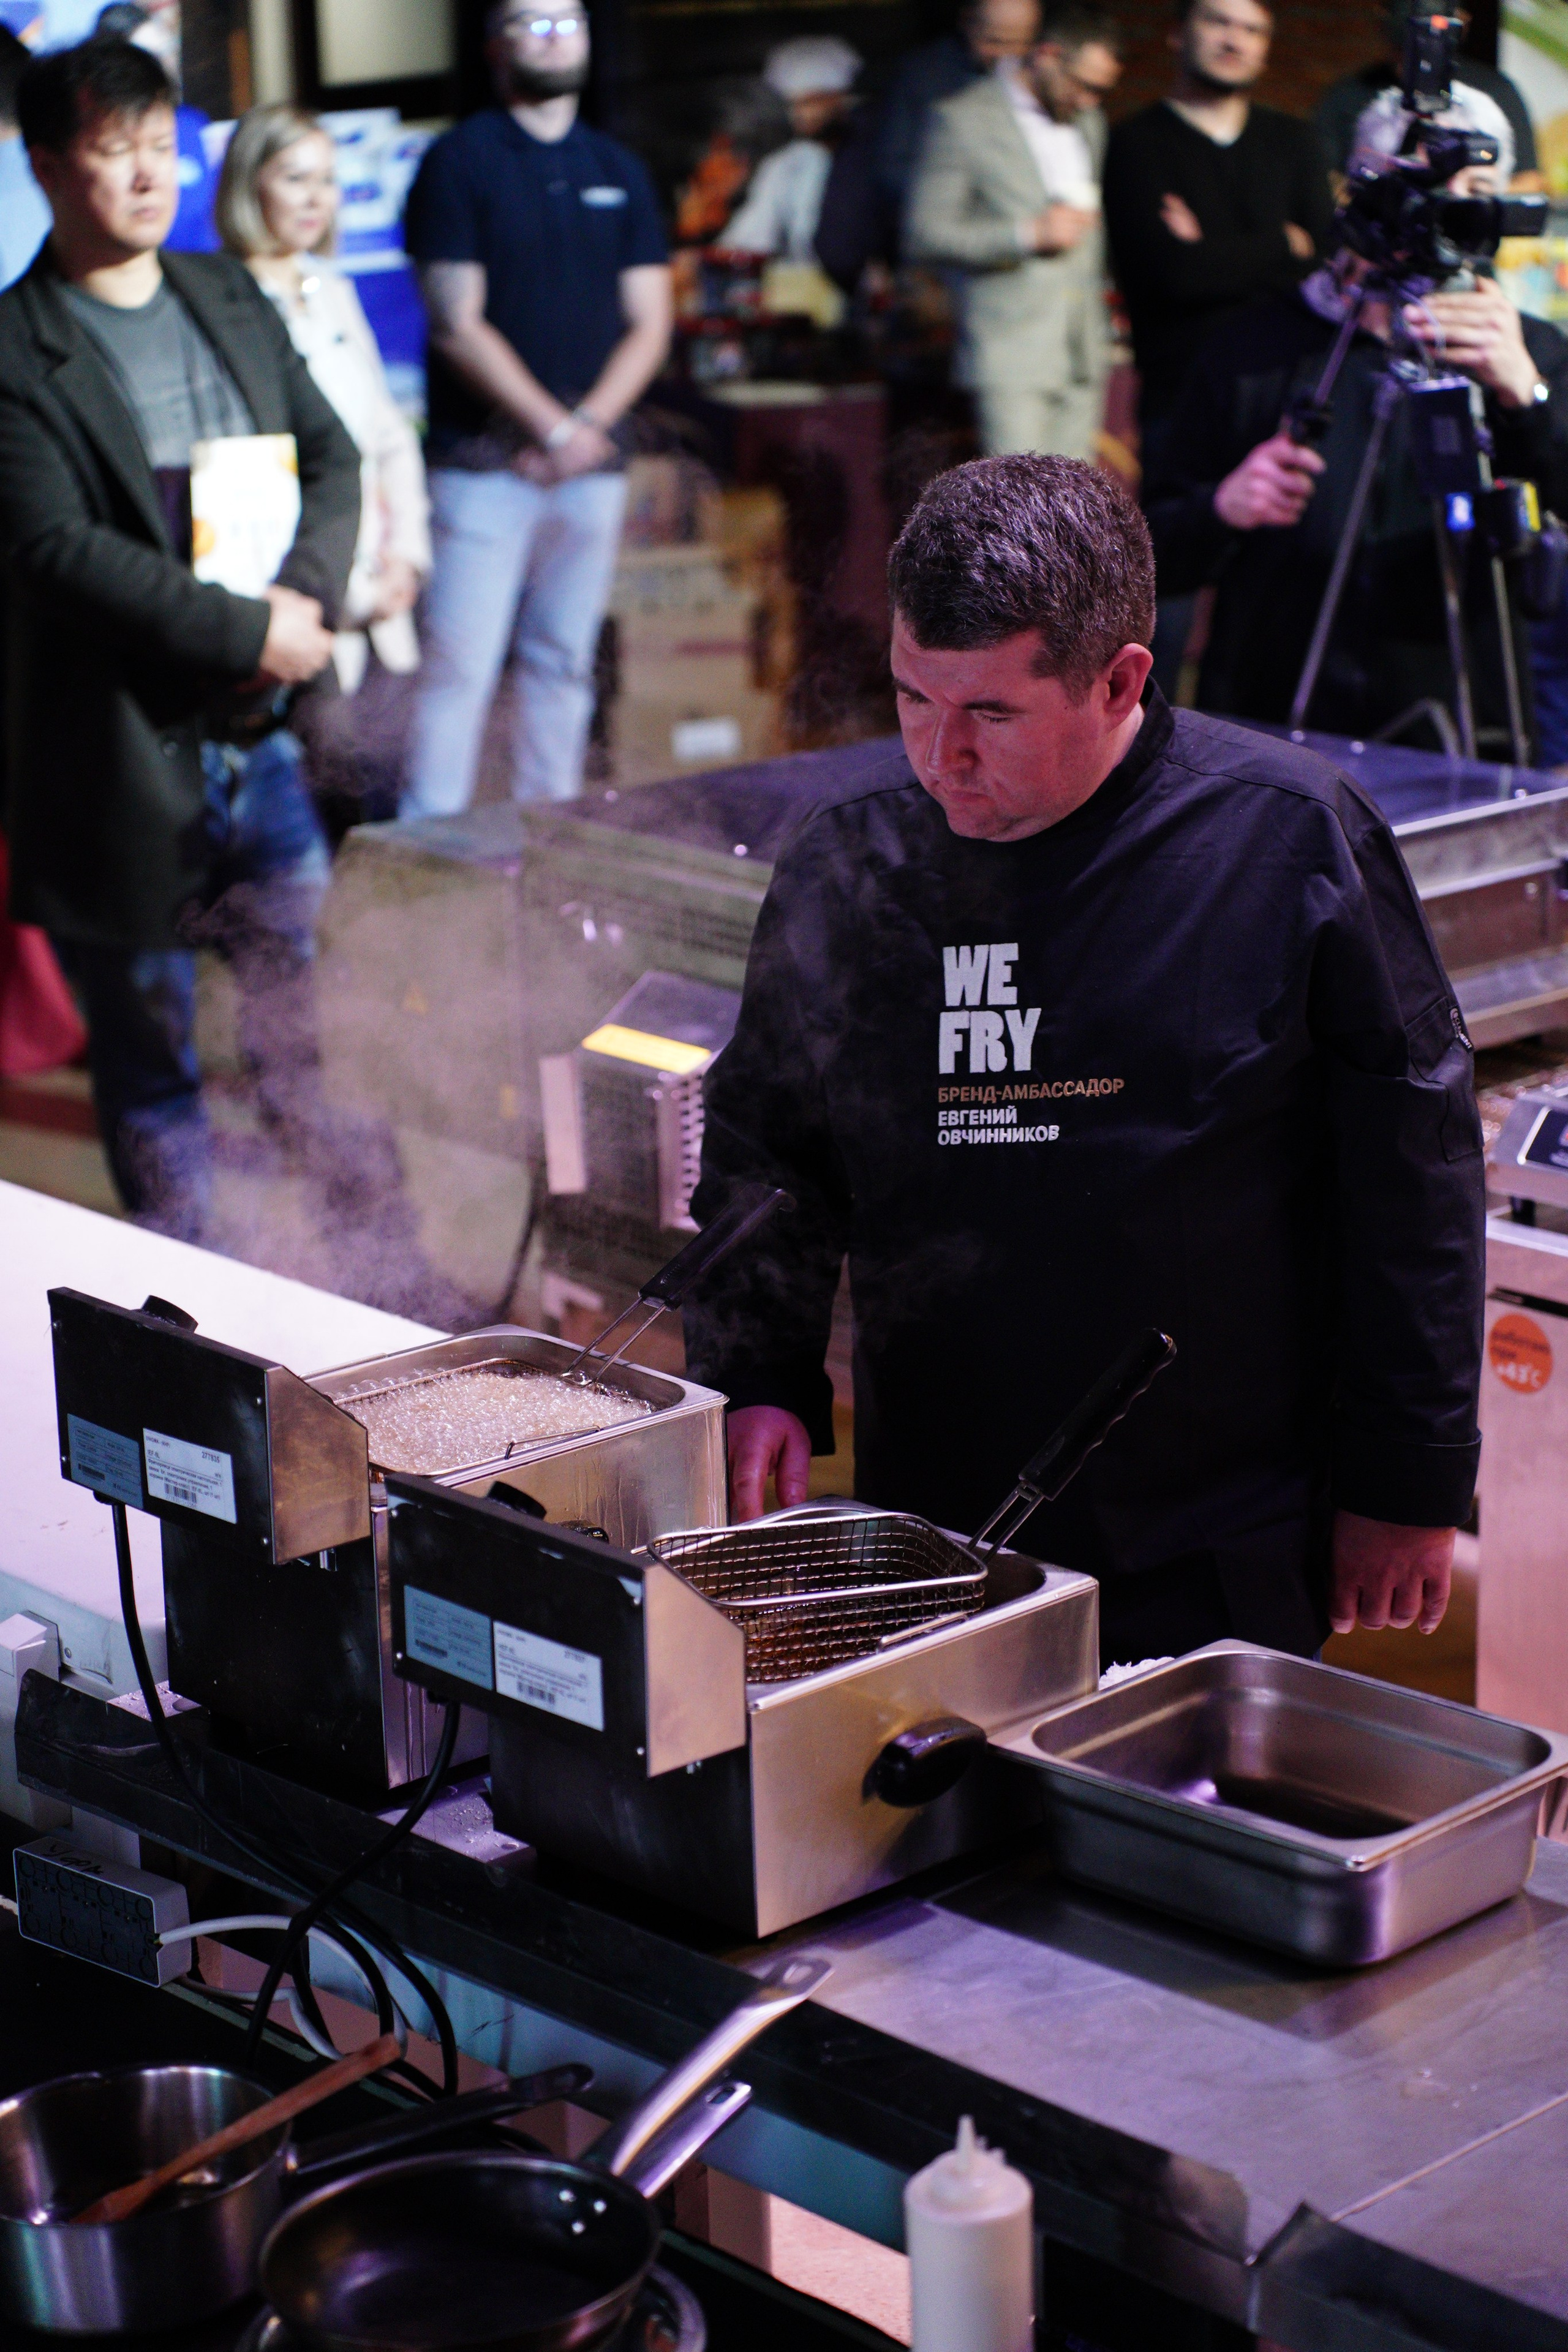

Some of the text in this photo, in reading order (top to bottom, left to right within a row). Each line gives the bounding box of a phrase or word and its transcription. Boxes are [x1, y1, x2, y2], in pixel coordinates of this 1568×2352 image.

[943, 943, 1019, 1006] WE
[939, 1008, 1041, 1074] FRY
[938, 1078, 1125, 1104] БРЕНД-АМБАССАДОР
[938, 1105, 1017, 1126] ЕВГЕНИЙ
[937, 1125, 1060, 1145] ОВЧИННИКОВ
[202, 1451, 220, 1463] 277835
